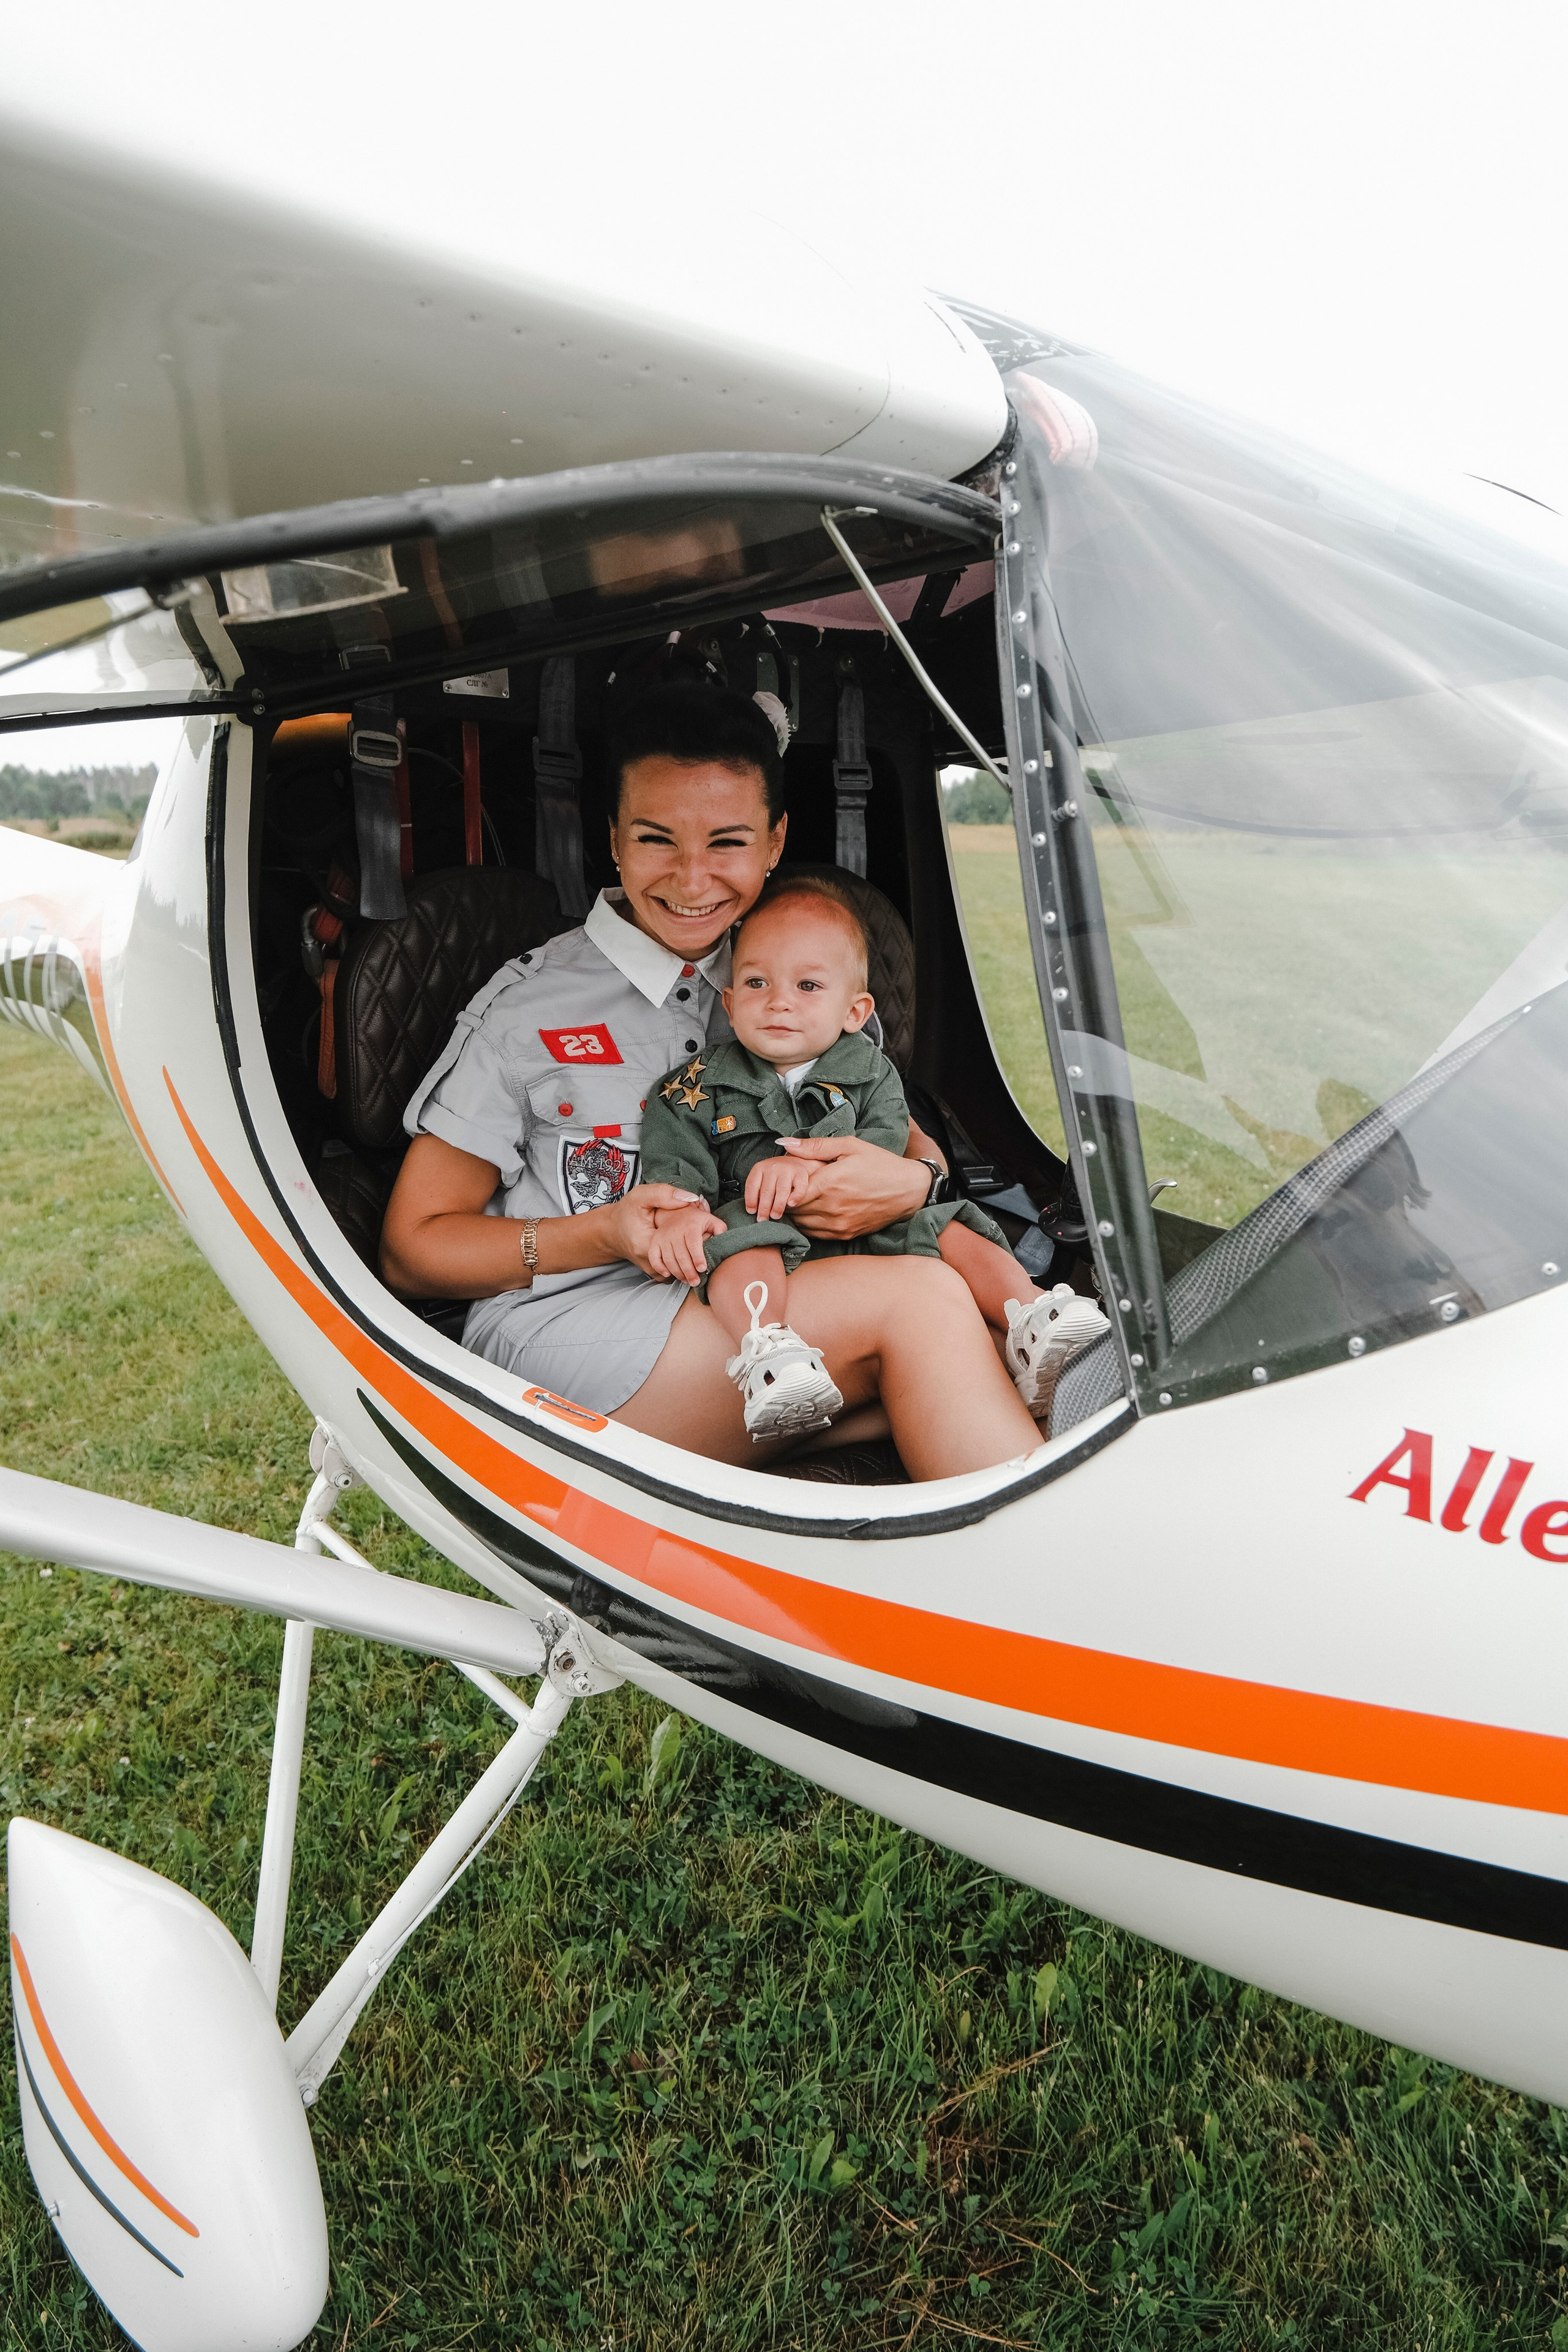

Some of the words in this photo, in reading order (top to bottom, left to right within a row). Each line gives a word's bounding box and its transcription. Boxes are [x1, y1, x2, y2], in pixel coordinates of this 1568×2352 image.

[559, 1034, 604, 1057] 23
[569, 1154, 630, 1174] AM-1923
[1345, 1427, 1568, 1564] Alle
